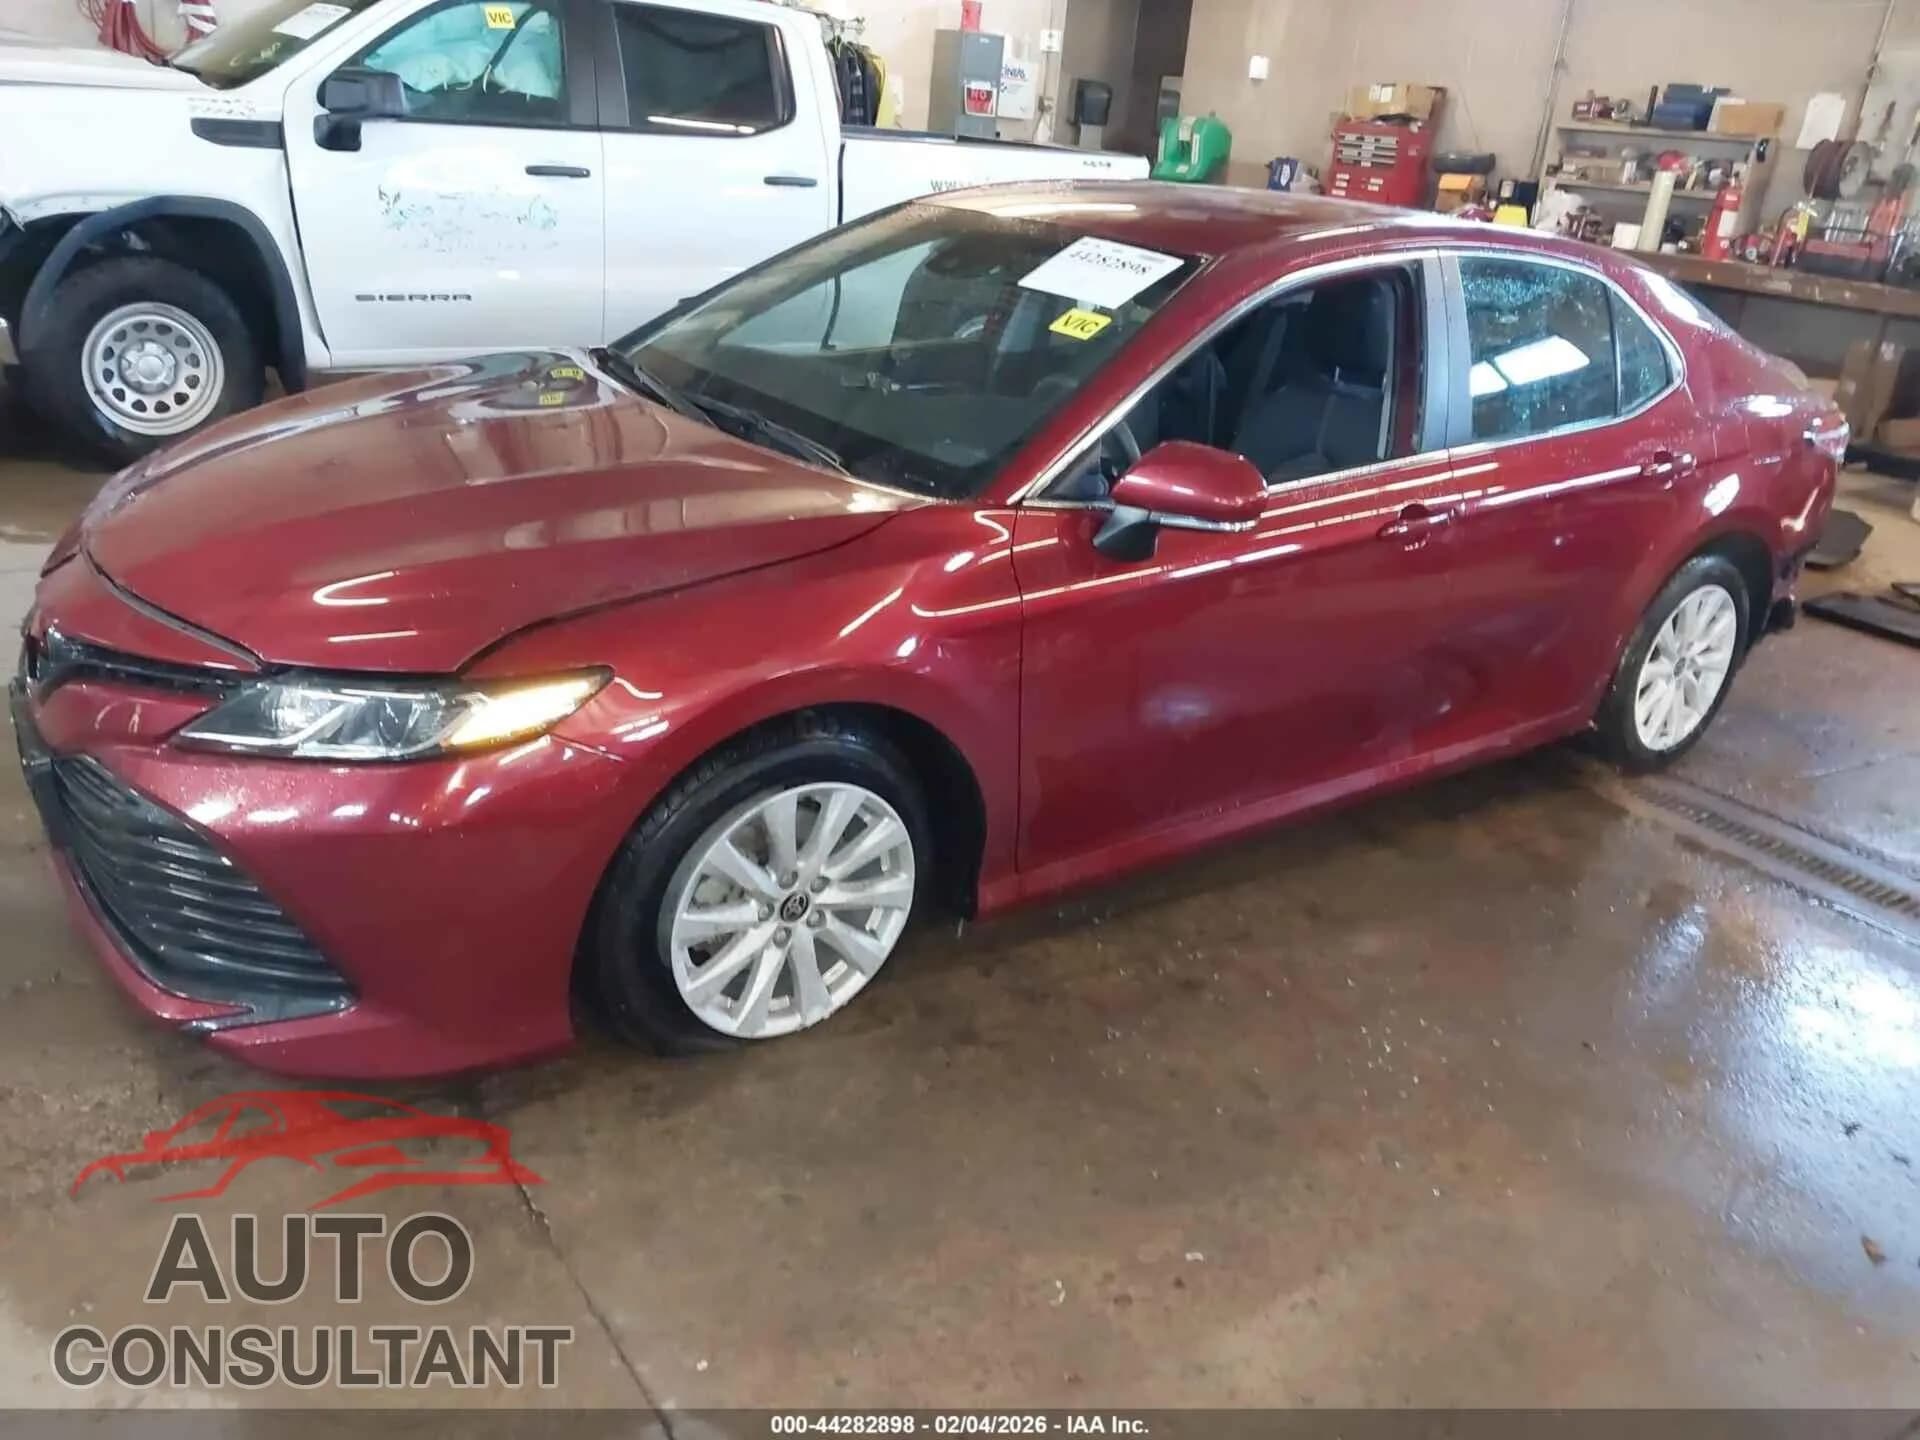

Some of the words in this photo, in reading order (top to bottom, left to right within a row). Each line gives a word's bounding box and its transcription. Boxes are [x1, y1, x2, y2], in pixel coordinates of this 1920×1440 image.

[488, 12, 512, 24] VIC
[355, 293, 472, 302] SIERRA
[1063, 315, 1099, 334] VIC
